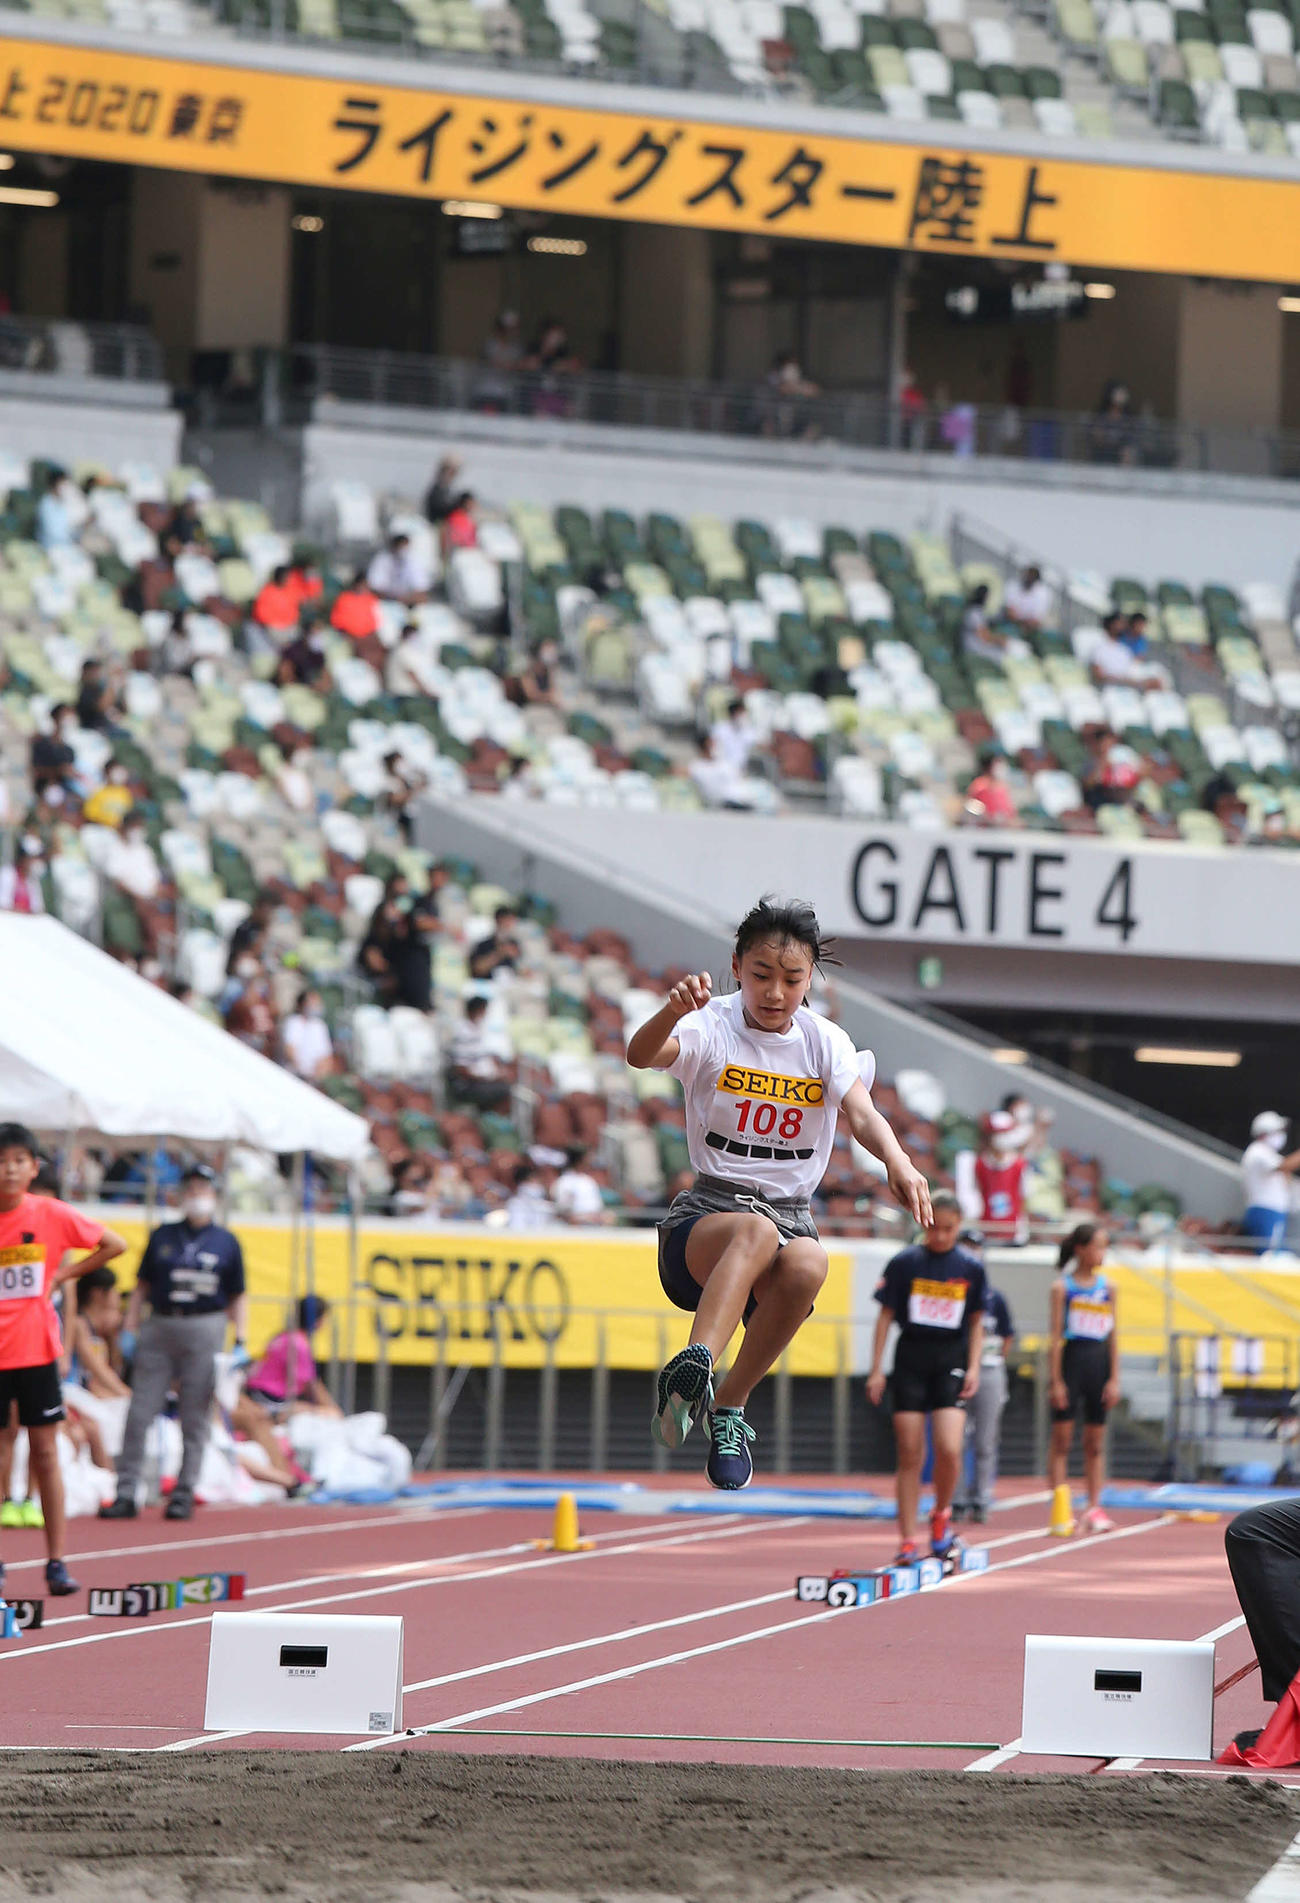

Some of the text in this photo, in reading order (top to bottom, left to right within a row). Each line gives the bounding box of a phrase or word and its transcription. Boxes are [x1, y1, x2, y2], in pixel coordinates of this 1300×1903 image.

[333, 97, 1060, 251] ライジングスター陸上
[850, 838, 1138, 943] GATE 4
[722, 1067, 823, 1104] SEIKO
[735, 1098, 804, 1140] 108
[366, 1253, 572, 1343] SEIKO
[90, 1589, 124, 1616] E
